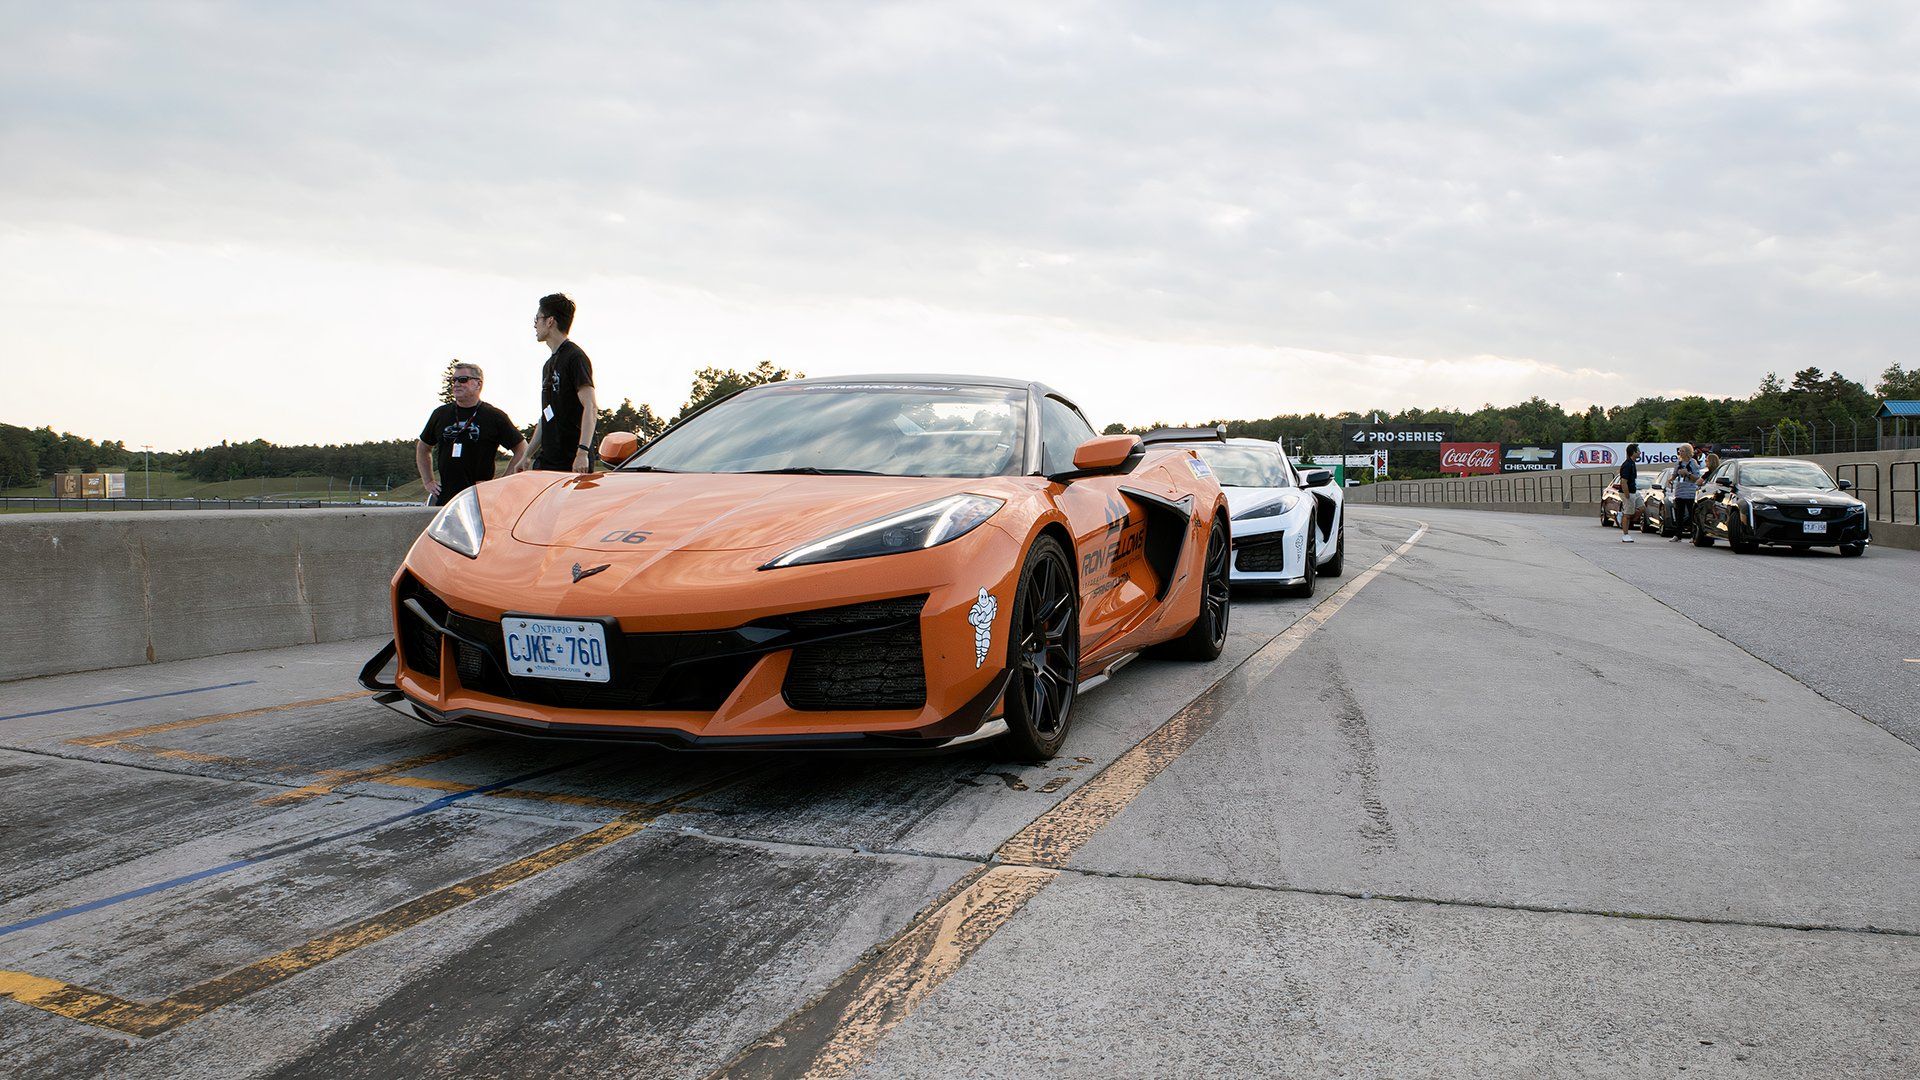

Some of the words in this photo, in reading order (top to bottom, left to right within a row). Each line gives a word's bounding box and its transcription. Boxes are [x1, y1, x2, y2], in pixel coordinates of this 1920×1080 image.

[1442, 448, 1496, 467] Coca-Cola
[1576, 450, 1612, 464] AER
[600, 530, 653, 544] 06
[508, 634, 555, 663] CJKE
[565, 636, 602, 666] 760
